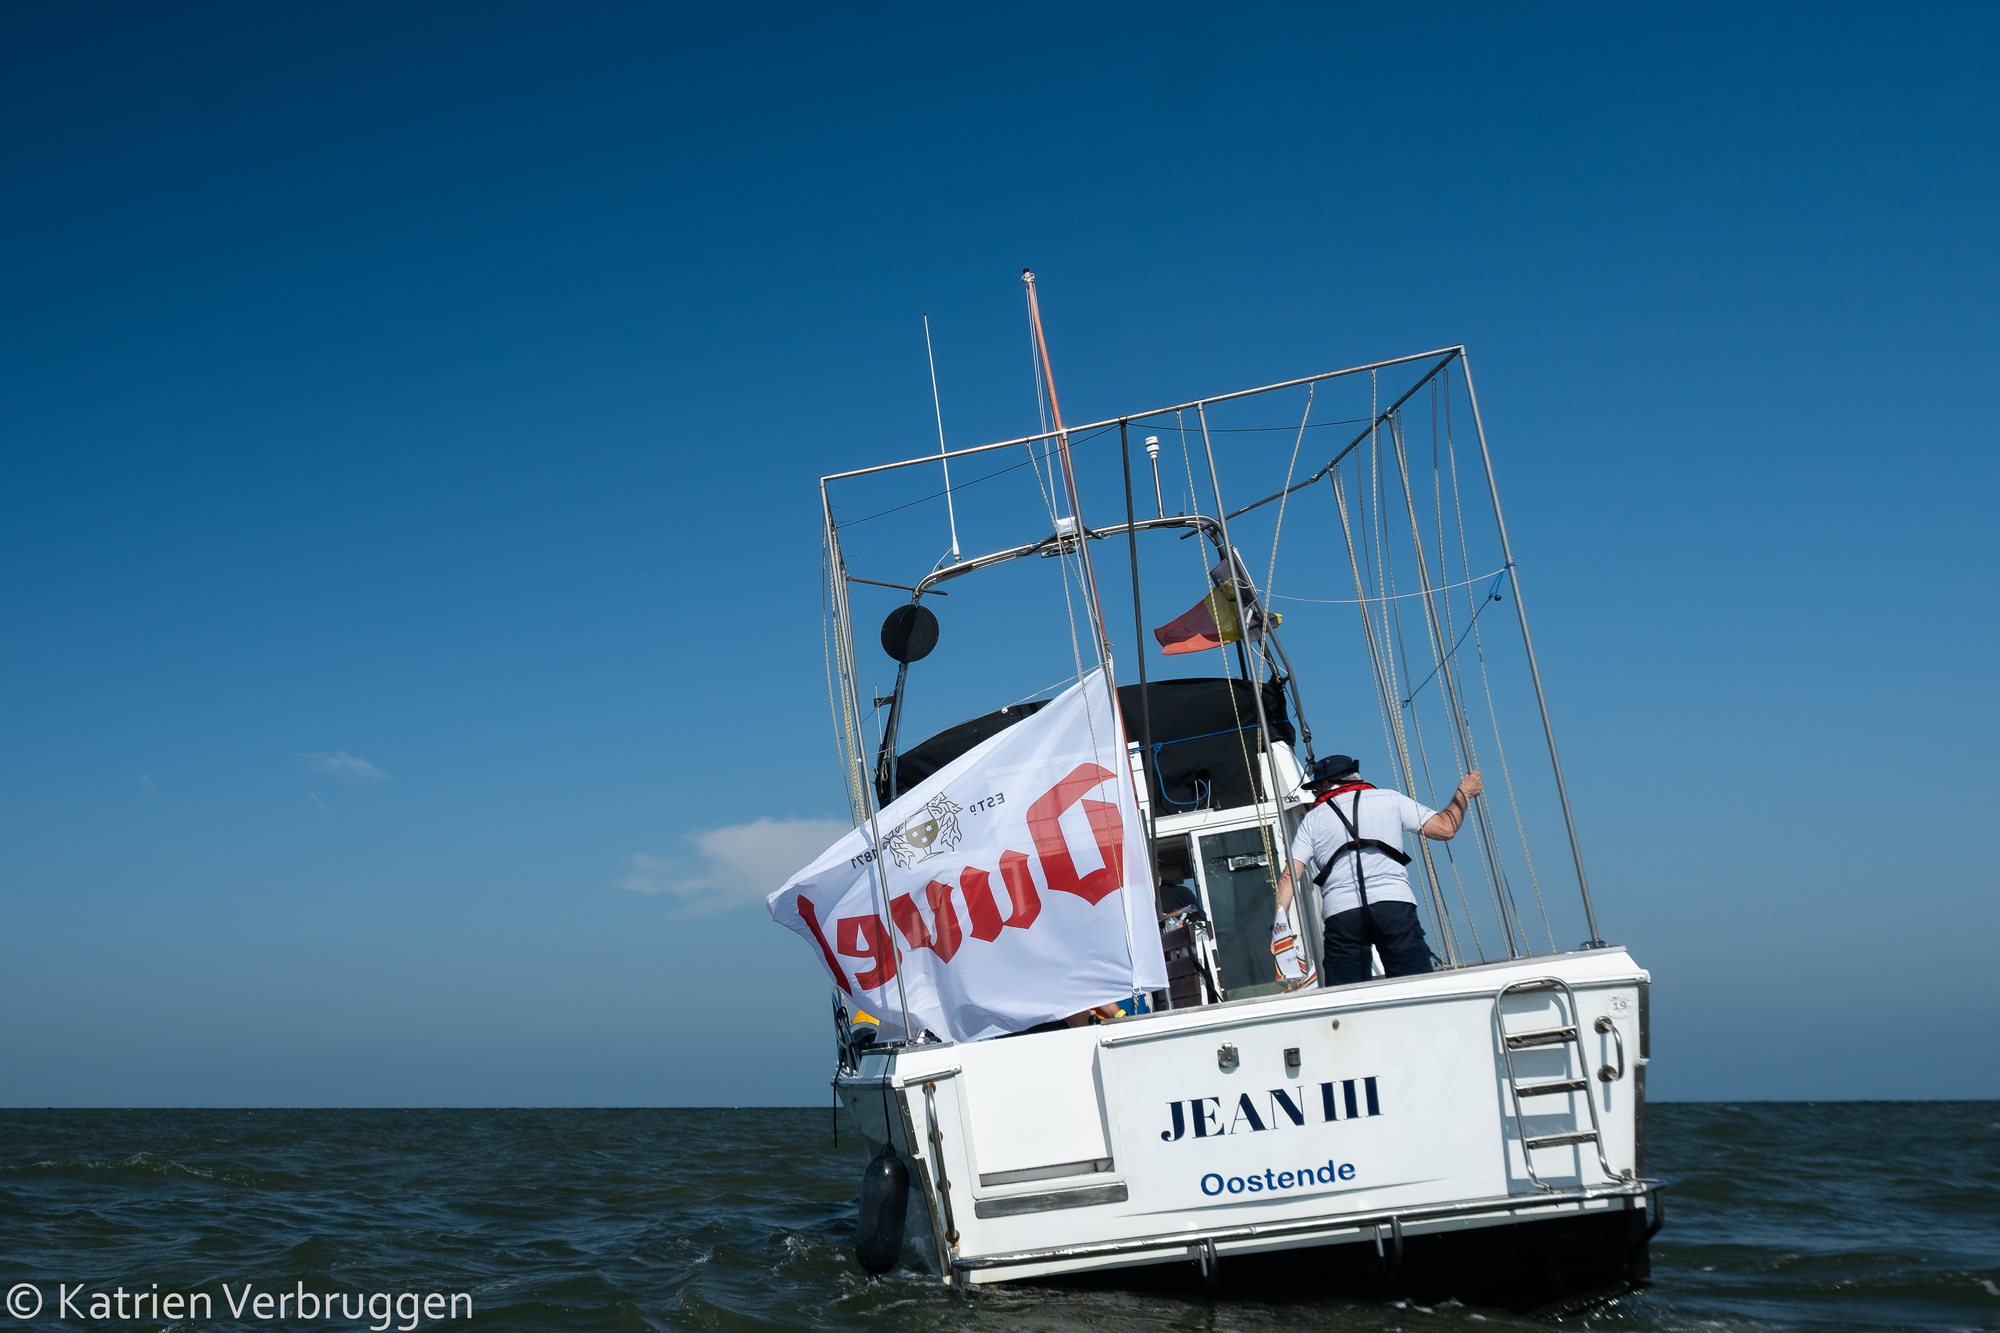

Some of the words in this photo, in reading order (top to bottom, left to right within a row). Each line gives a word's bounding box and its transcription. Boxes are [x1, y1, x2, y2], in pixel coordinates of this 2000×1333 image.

[1160, 1086, 1306, 1142] JEAN
[1317, 1076, 1384, 1123] III
[1200, 1159, 1356, 1196] Oostende
